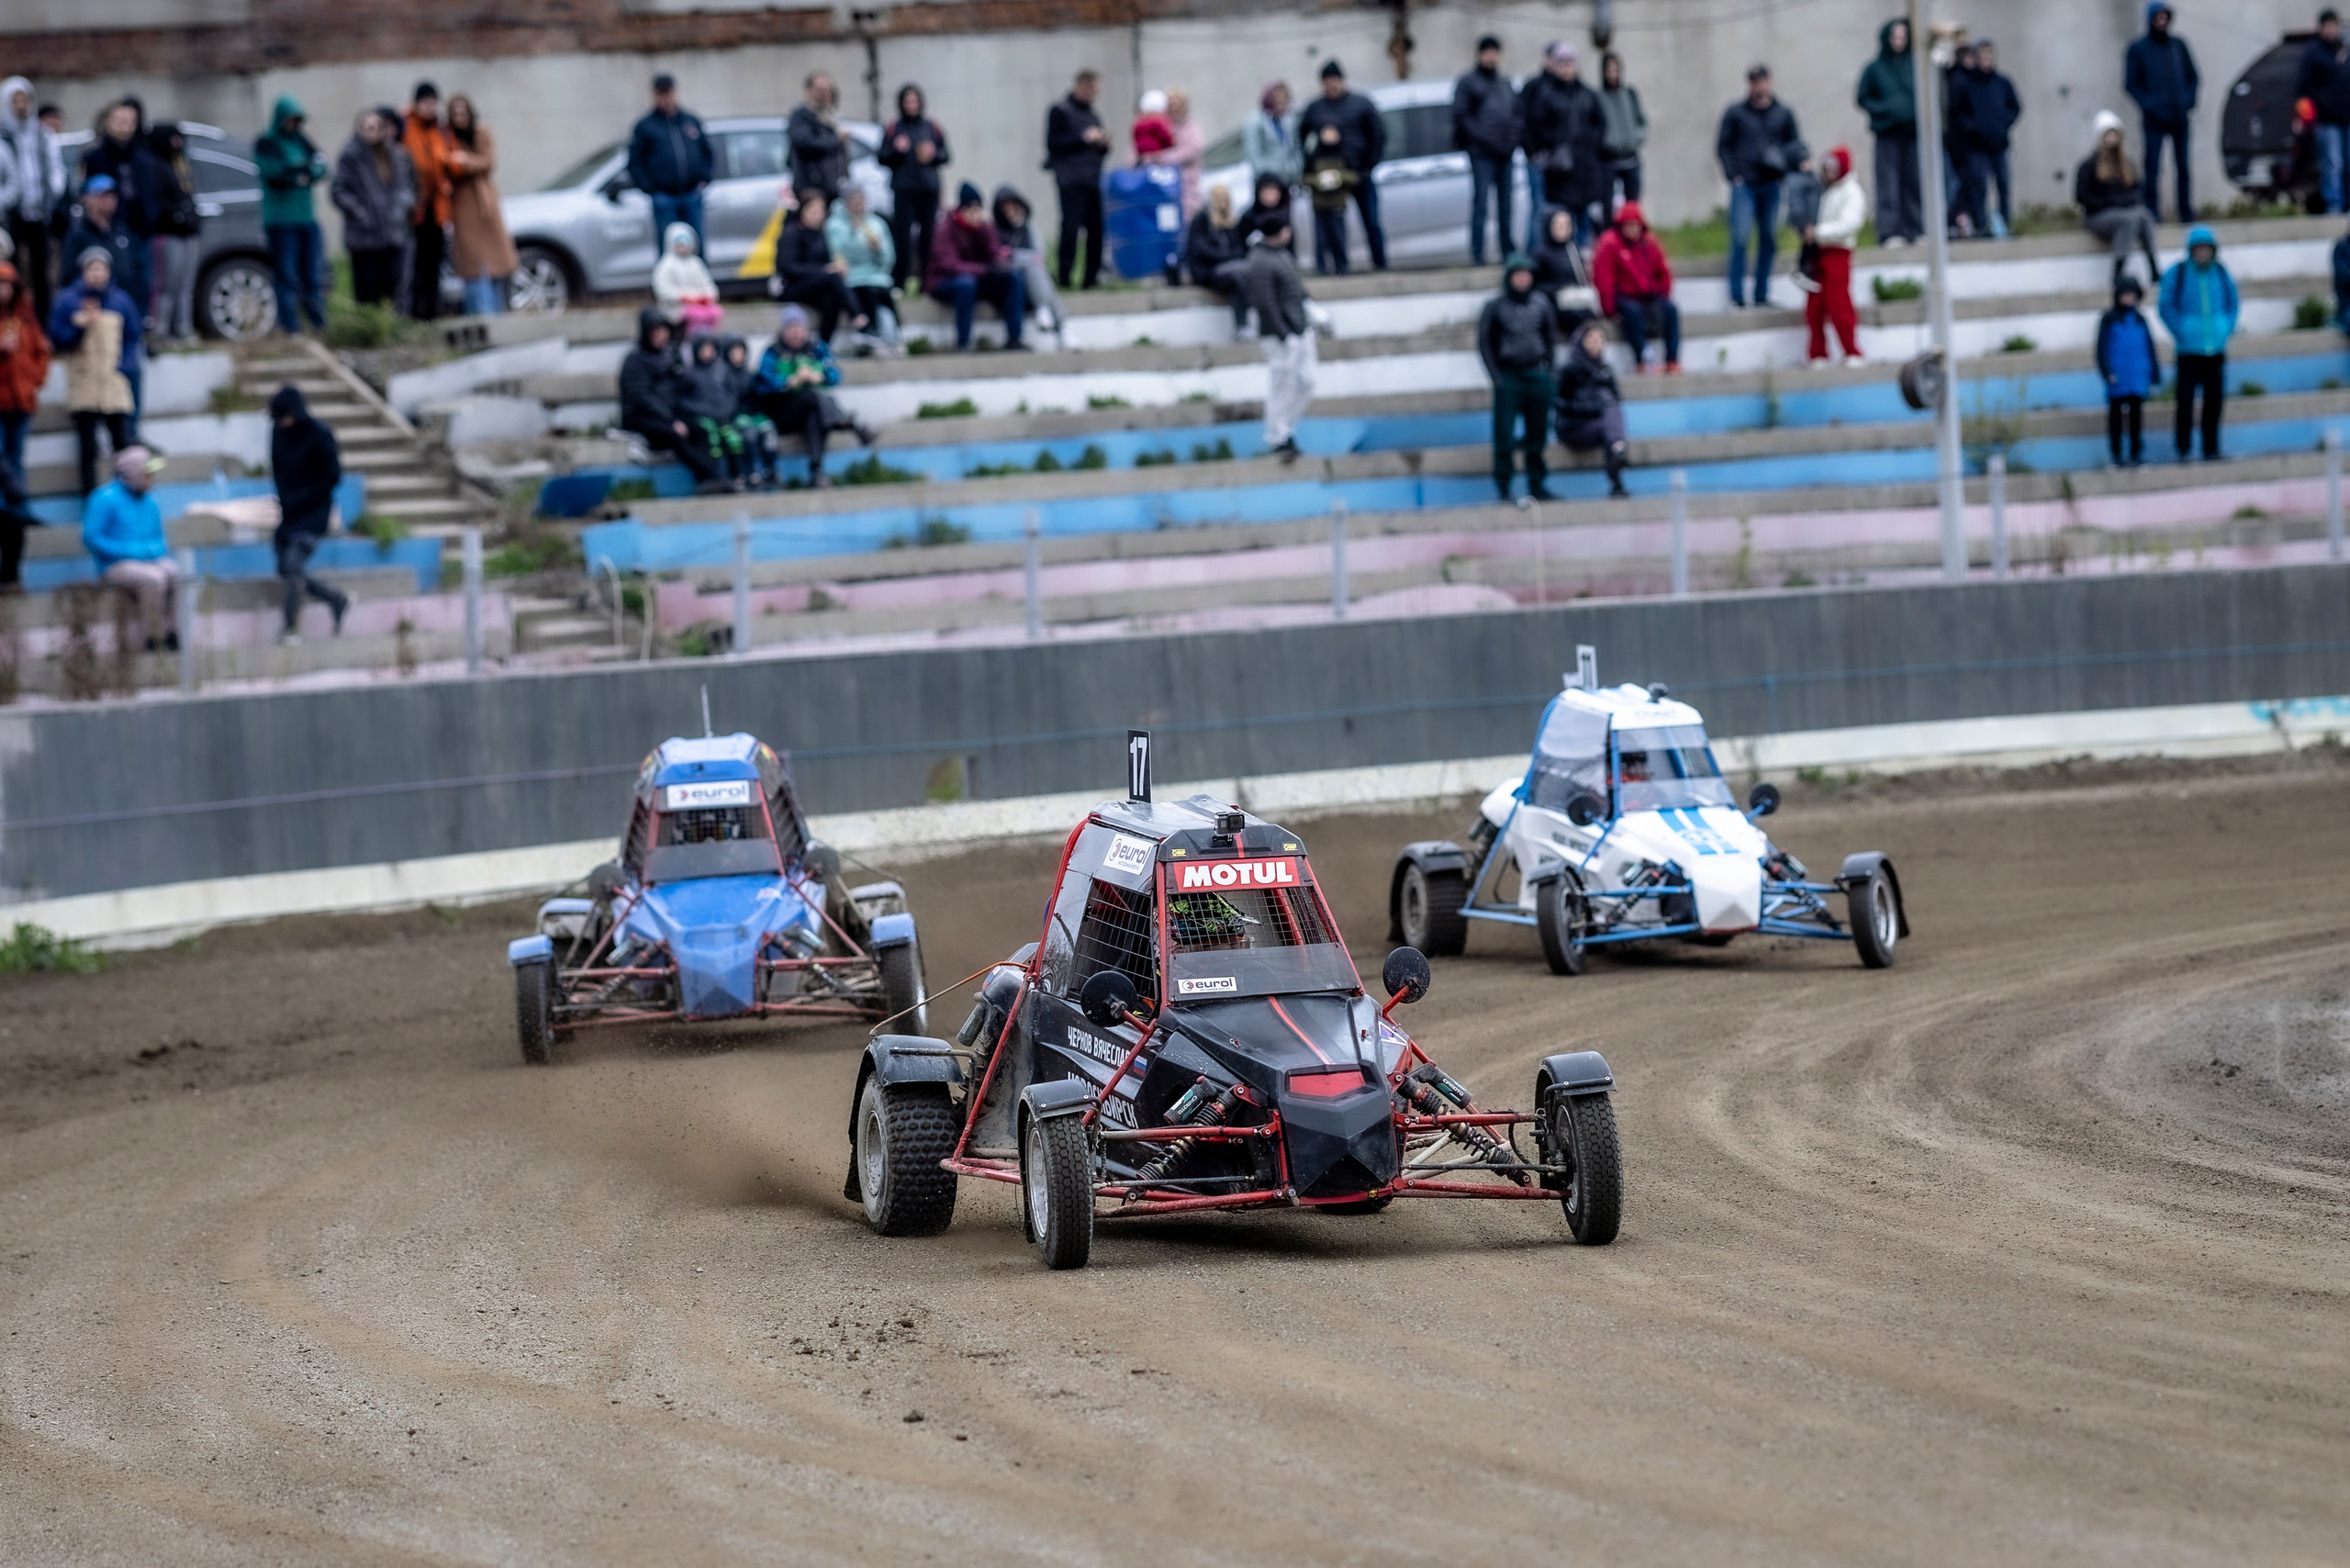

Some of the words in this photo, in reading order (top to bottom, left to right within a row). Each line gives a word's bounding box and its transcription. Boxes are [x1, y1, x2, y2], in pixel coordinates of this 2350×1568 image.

[1129, 736, 1147, 797] 17
[692, 784, 746, 799] eurol
[1118, 845, 1152, 865] eurol
[1182, 861, 1293, 889] MOTUL
[1195, 978, 1233, 989] eurol
[1068, 1025, 1092, 1054] ЧЕРНОВ
